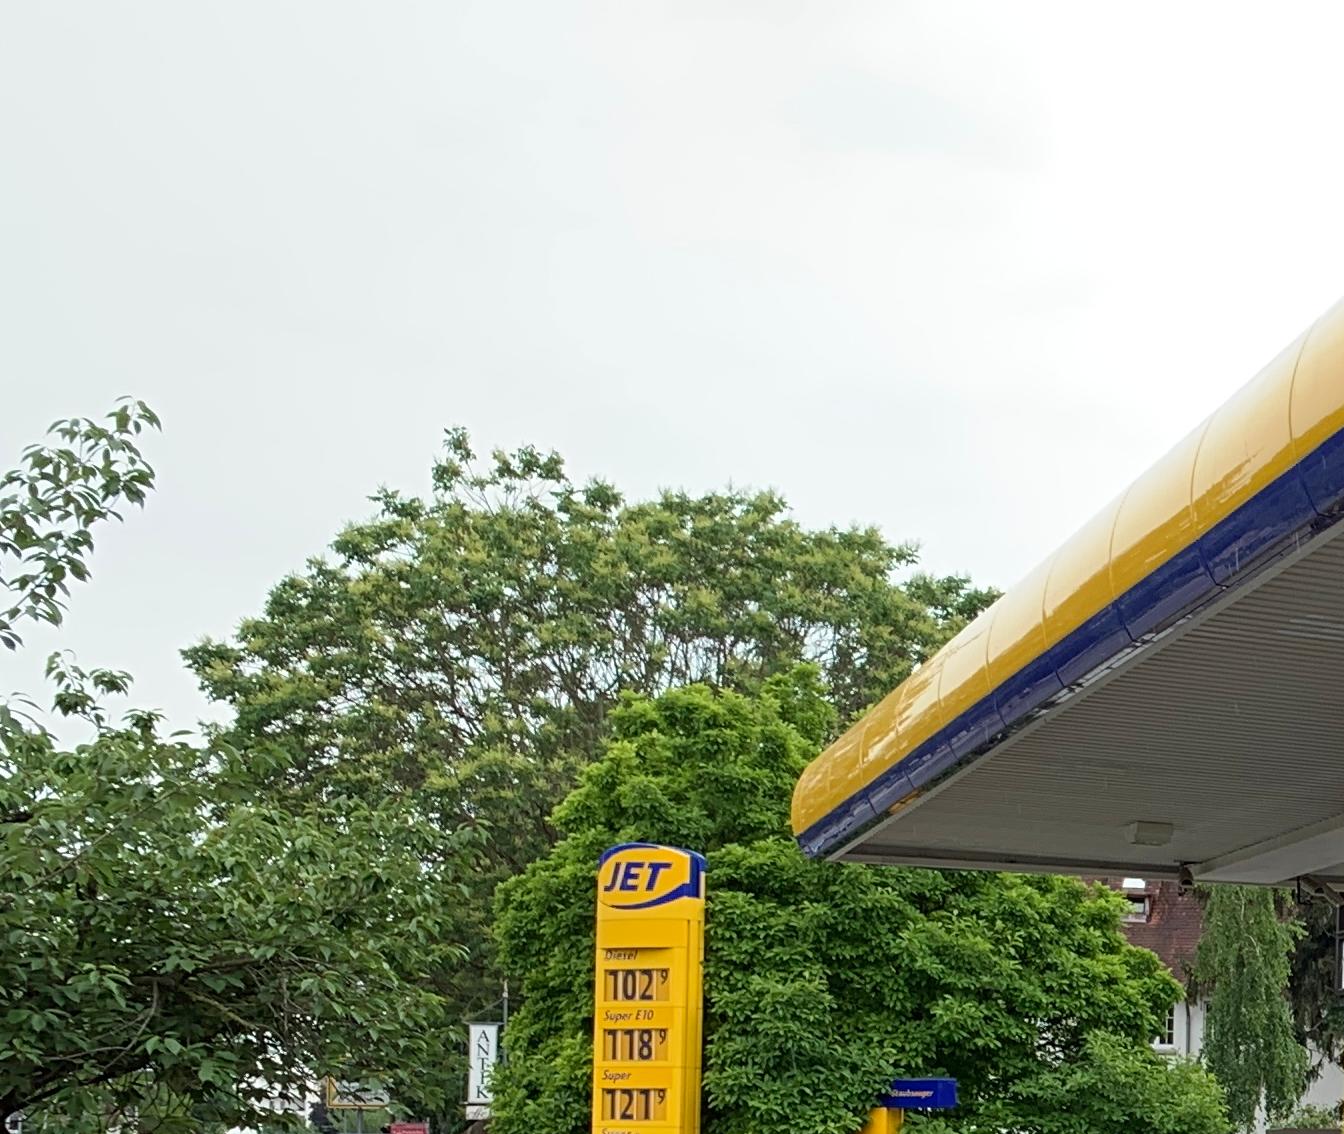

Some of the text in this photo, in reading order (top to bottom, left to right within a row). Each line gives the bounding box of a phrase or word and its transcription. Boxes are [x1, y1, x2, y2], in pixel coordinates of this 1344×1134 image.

[603, 861, 673, 892] JET
[604, 949, 638, 961] Diesel
[604, 1009, 655, 1023] Super E10
[602, 1069, 632, 1083] Super
